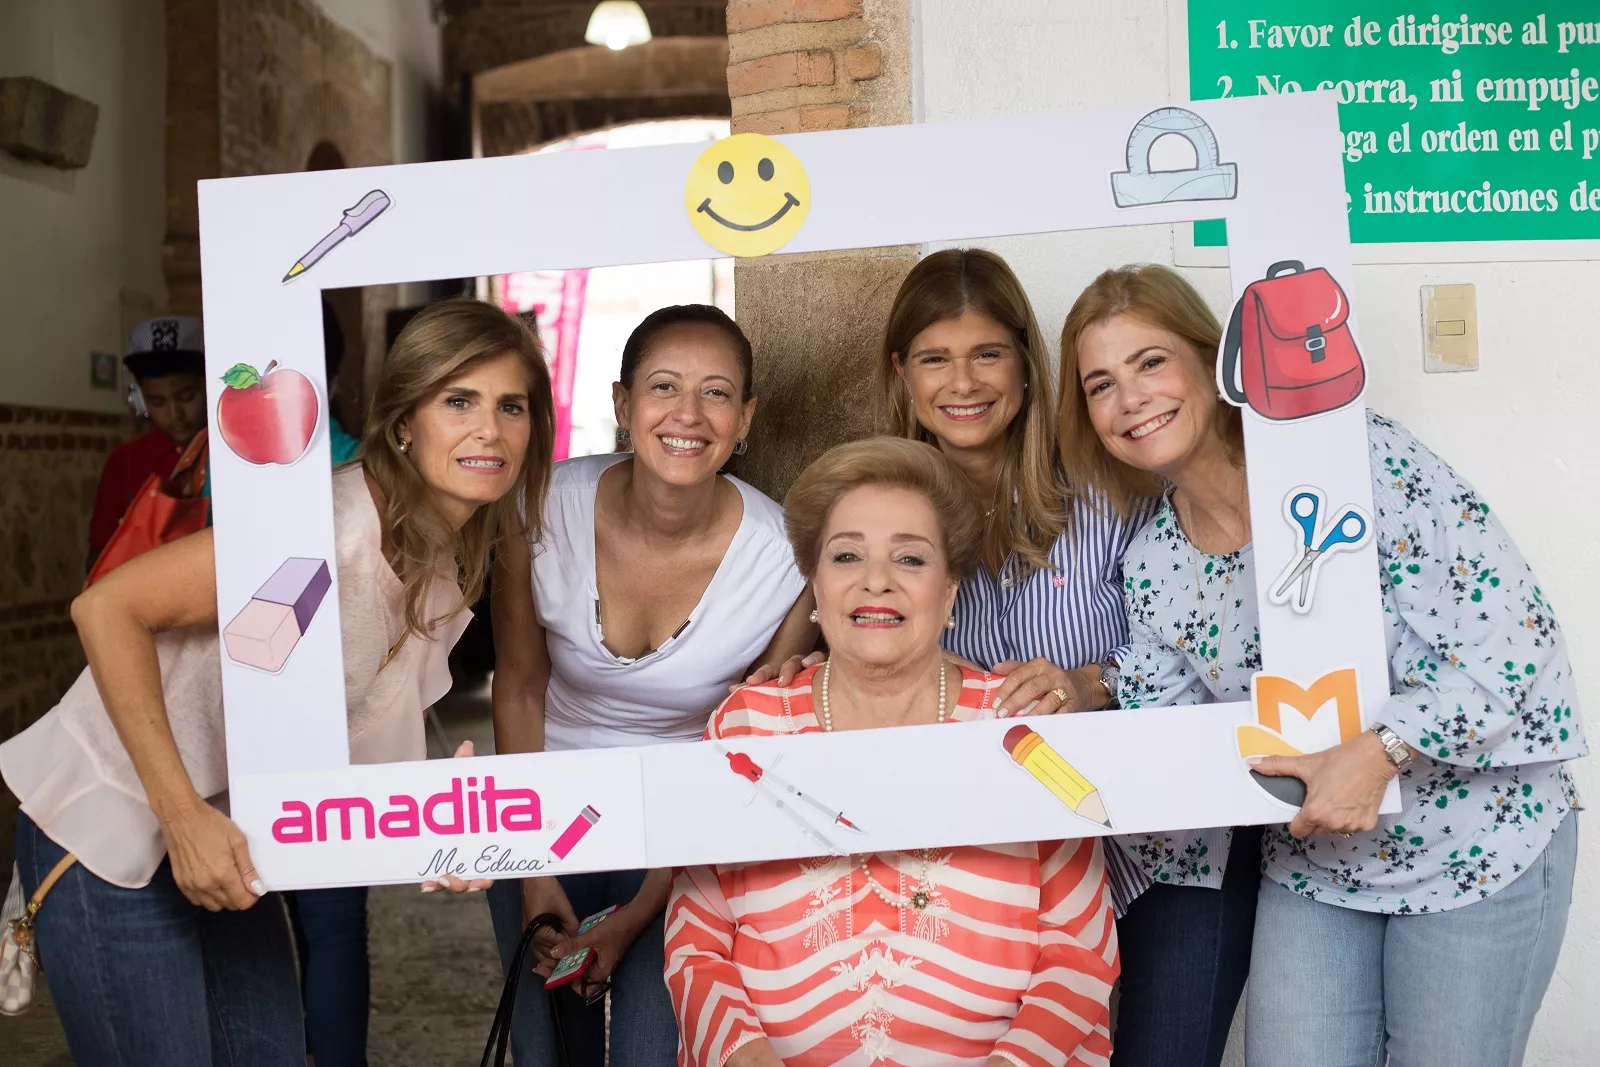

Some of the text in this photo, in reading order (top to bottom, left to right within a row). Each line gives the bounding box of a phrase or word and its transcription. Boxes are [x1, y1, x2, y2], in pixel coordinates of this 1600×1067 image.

[1216, 20, 1239, 49] 1.
[1248, 20, 1334, 49] Favor
[1344, 16, 1381, 46] de
[1389, 14, 1513, 54] dirigirse
[1522, 14, 1548, 45] al
[1430, 69, 1464, 103] ni
[1476, 68, 1599, 111] empuje
[1387, 121, 1412, 154] el
[1421, 120, 1500, 153] orden
[1508, 128, 1541, 152] en
[1549, 119, 1574, 151] el
[1363, 180, 1559, 214] instrucciones
[271, 776, 543, 845] amadita
[418, 845, 544, 876] Me Educa
